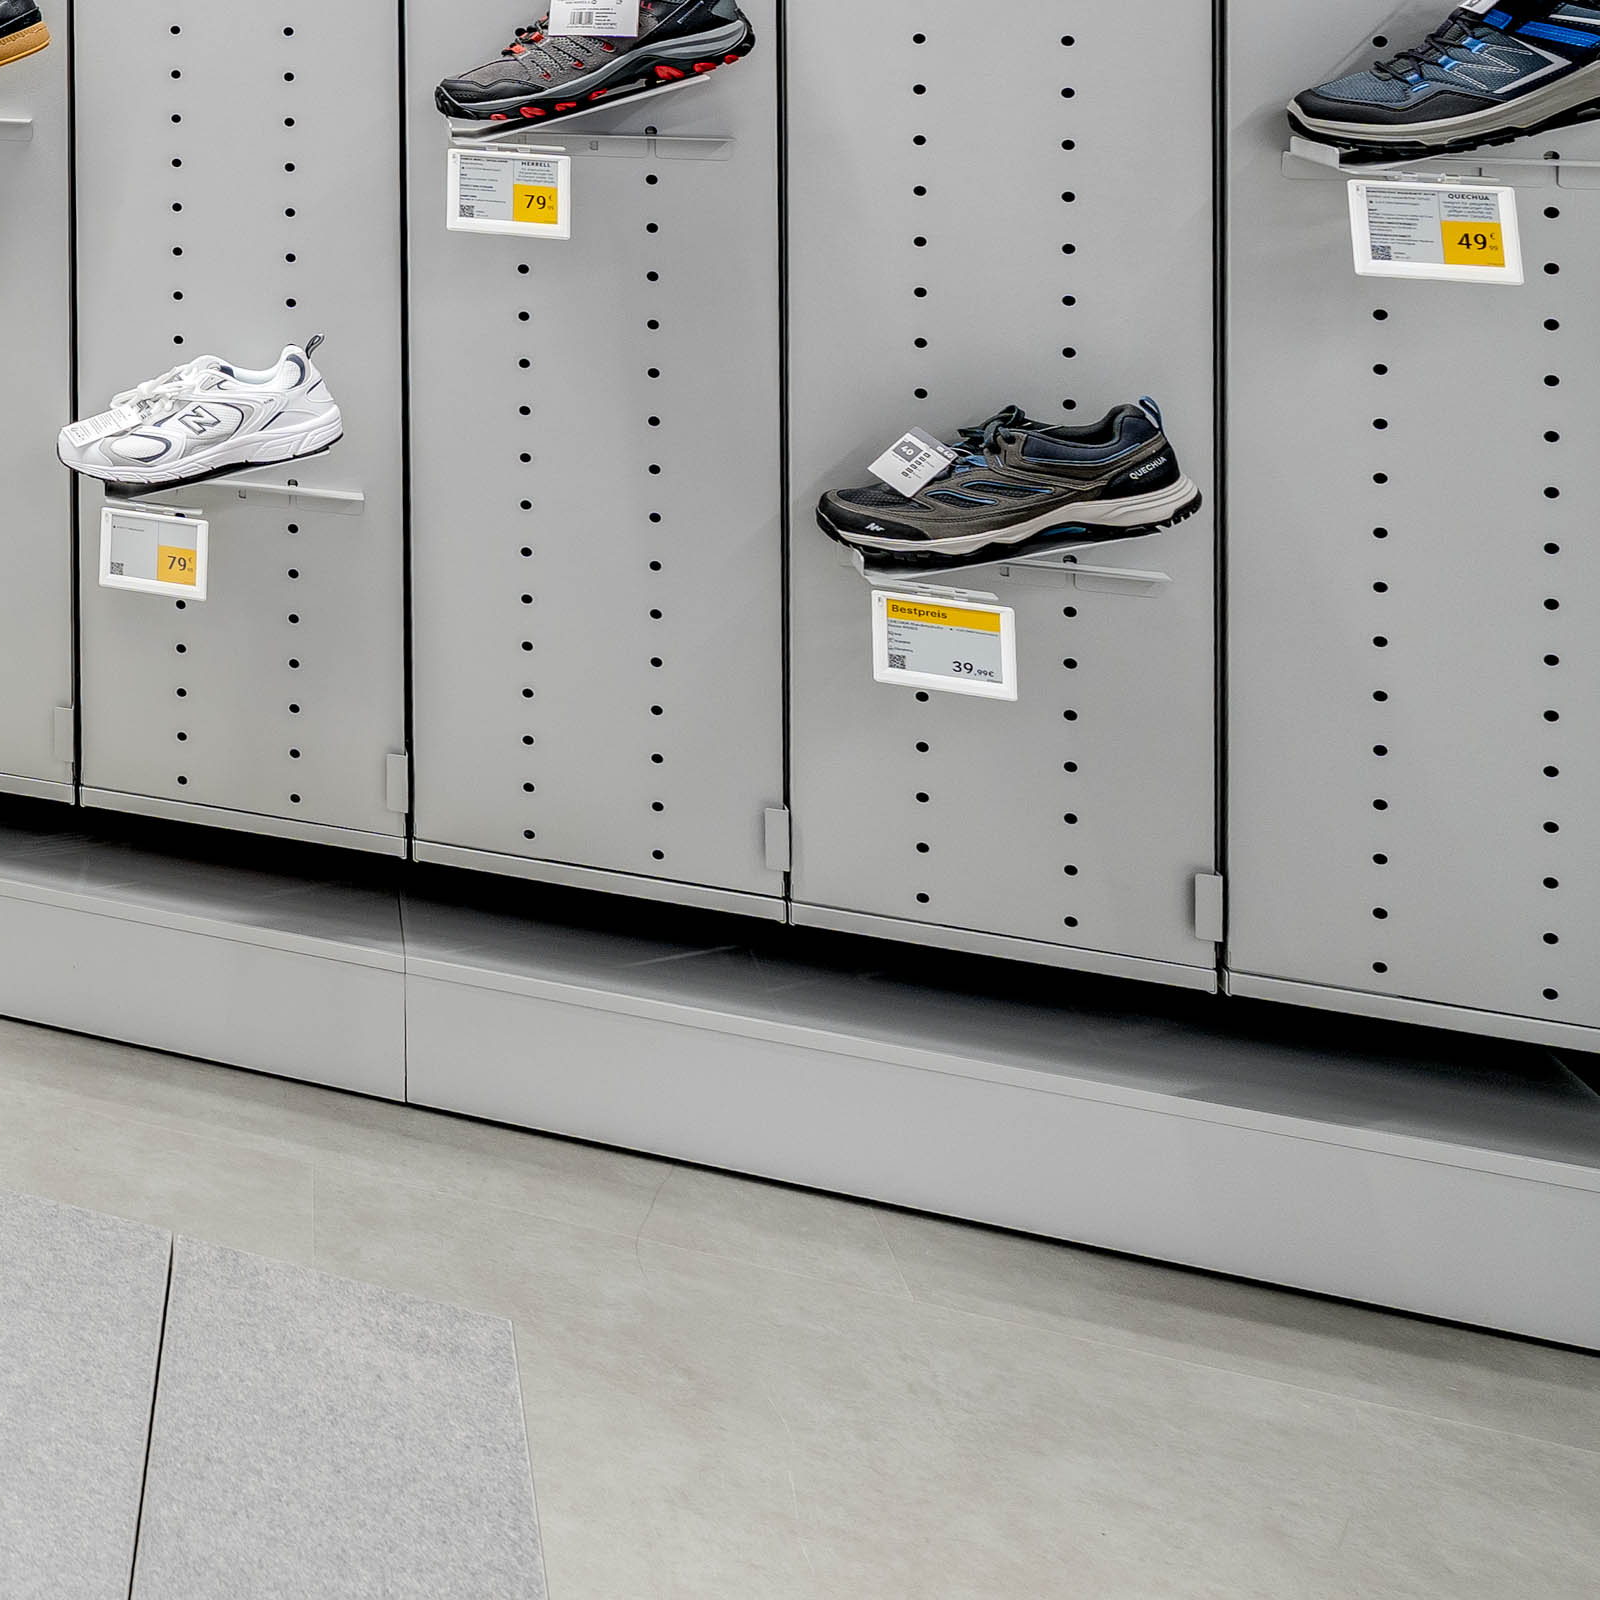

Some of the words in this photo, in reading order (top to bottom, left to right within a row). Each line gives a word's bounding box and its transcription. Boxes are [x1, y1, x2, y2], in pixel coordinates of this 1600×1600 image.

[524, 194, 546, 209] 79
[1447, 193, 1490, 201] QUECHUA
[1457, 232, 1487, 250] 49
[901, 445, 914, 456] 40
[1129, 456, 1167, 480] QUECHUA
[167, 555, 187, 571] 79
[891, 604, 948, 619] Bestpreis
